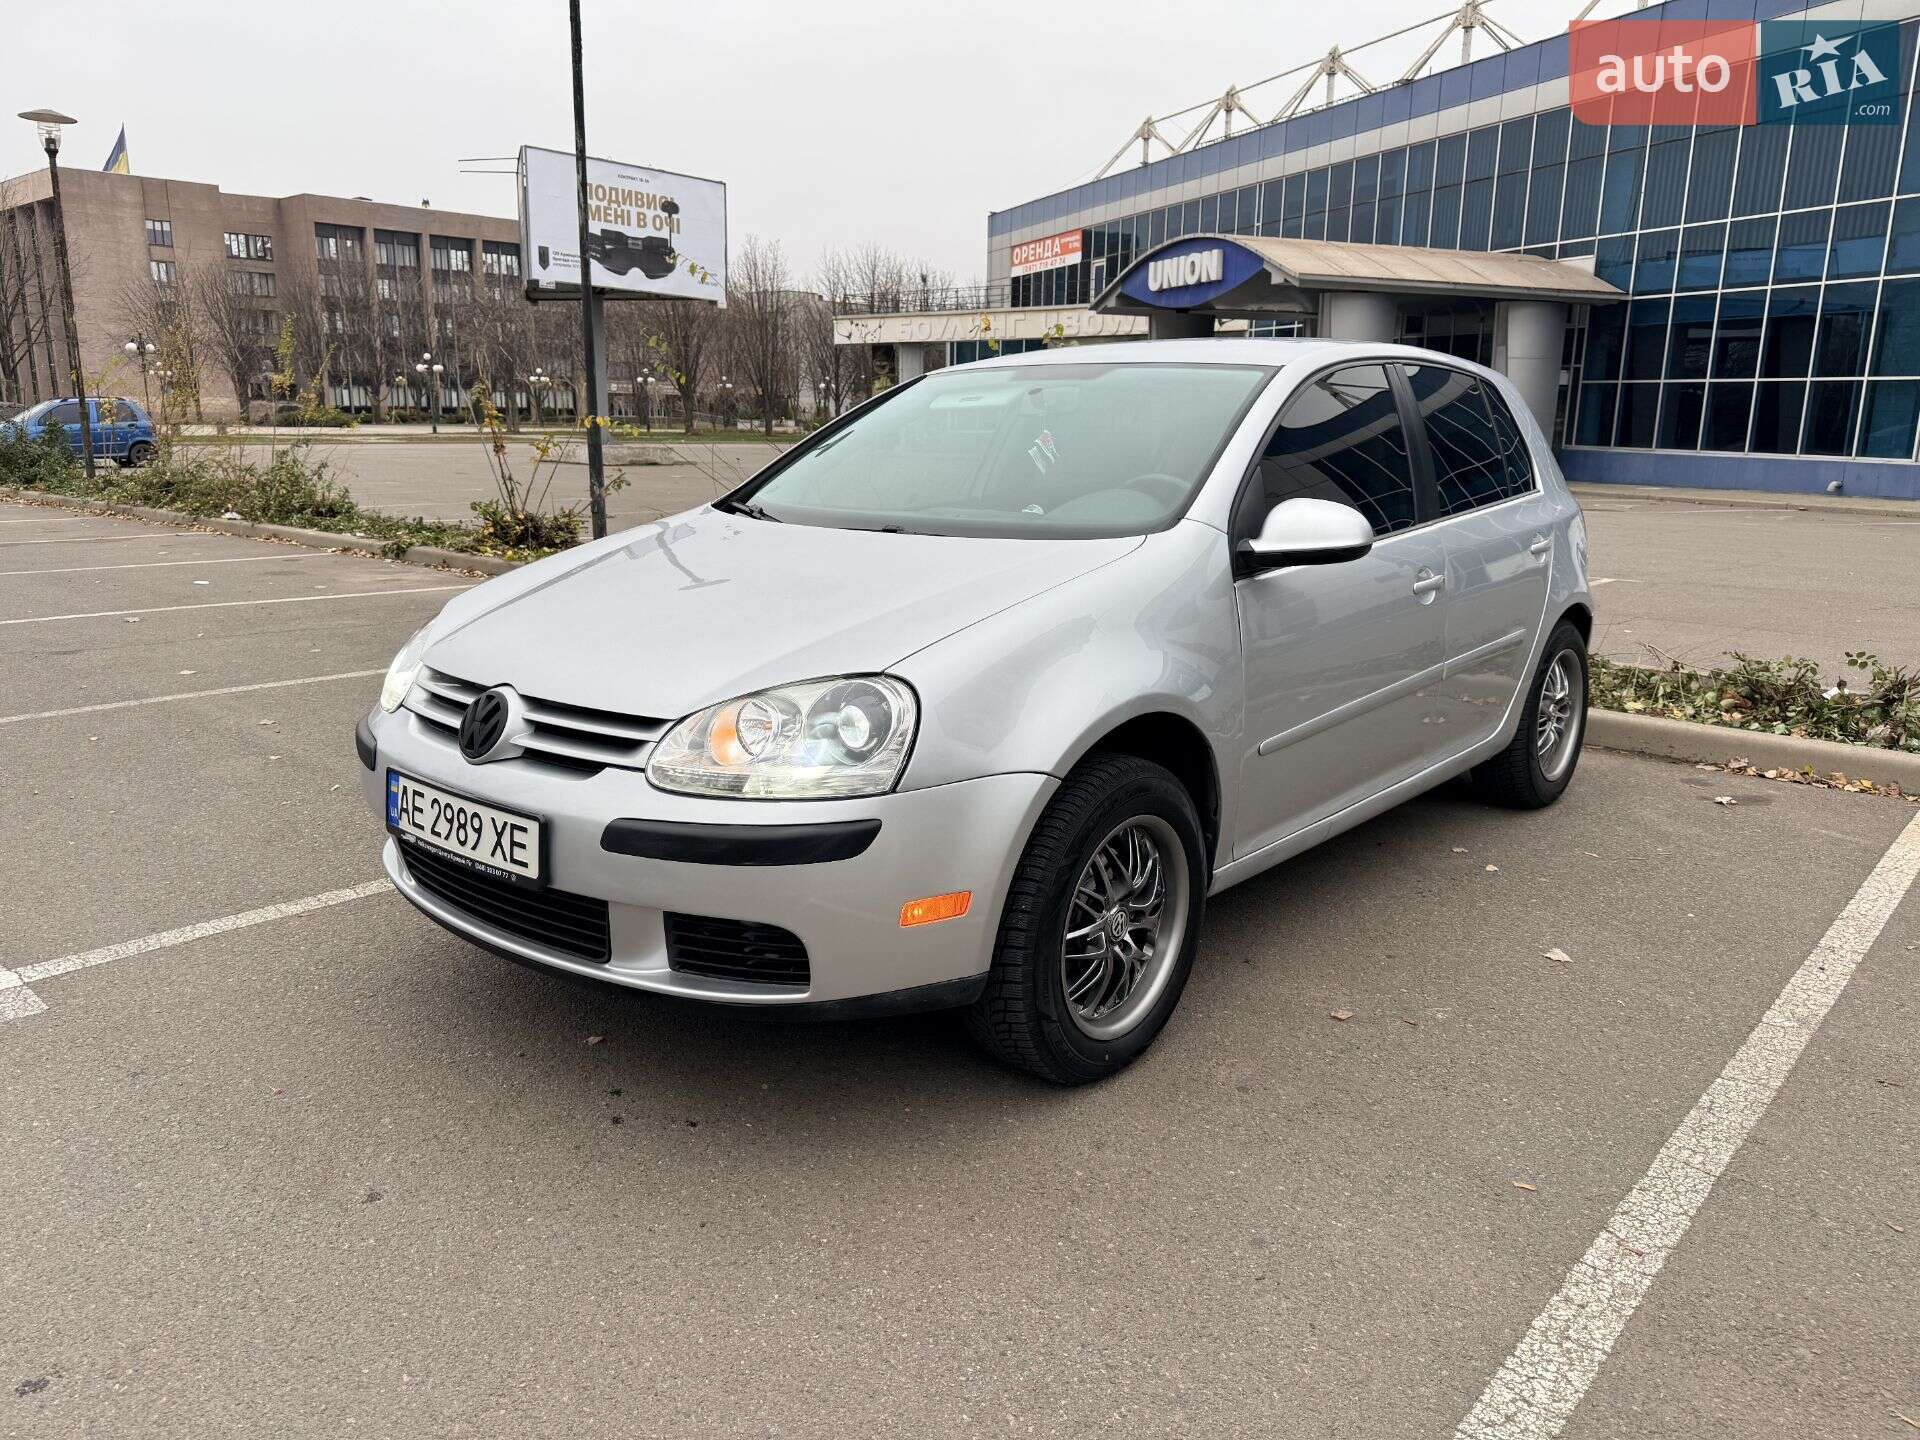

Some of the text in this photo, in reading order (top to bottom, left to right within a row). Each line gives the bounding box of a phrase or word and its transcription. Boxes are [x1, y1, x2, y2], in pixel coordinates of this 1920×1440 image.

[587, 182, 674, 211] ОДИВИС
[636, 211, 648, 228] В
[1012, 237, 1061, 265] ОРЕНДА
[1148, 249, 1224, 292] UNION
[399, 784, 529, 869] AE 2989 XE
